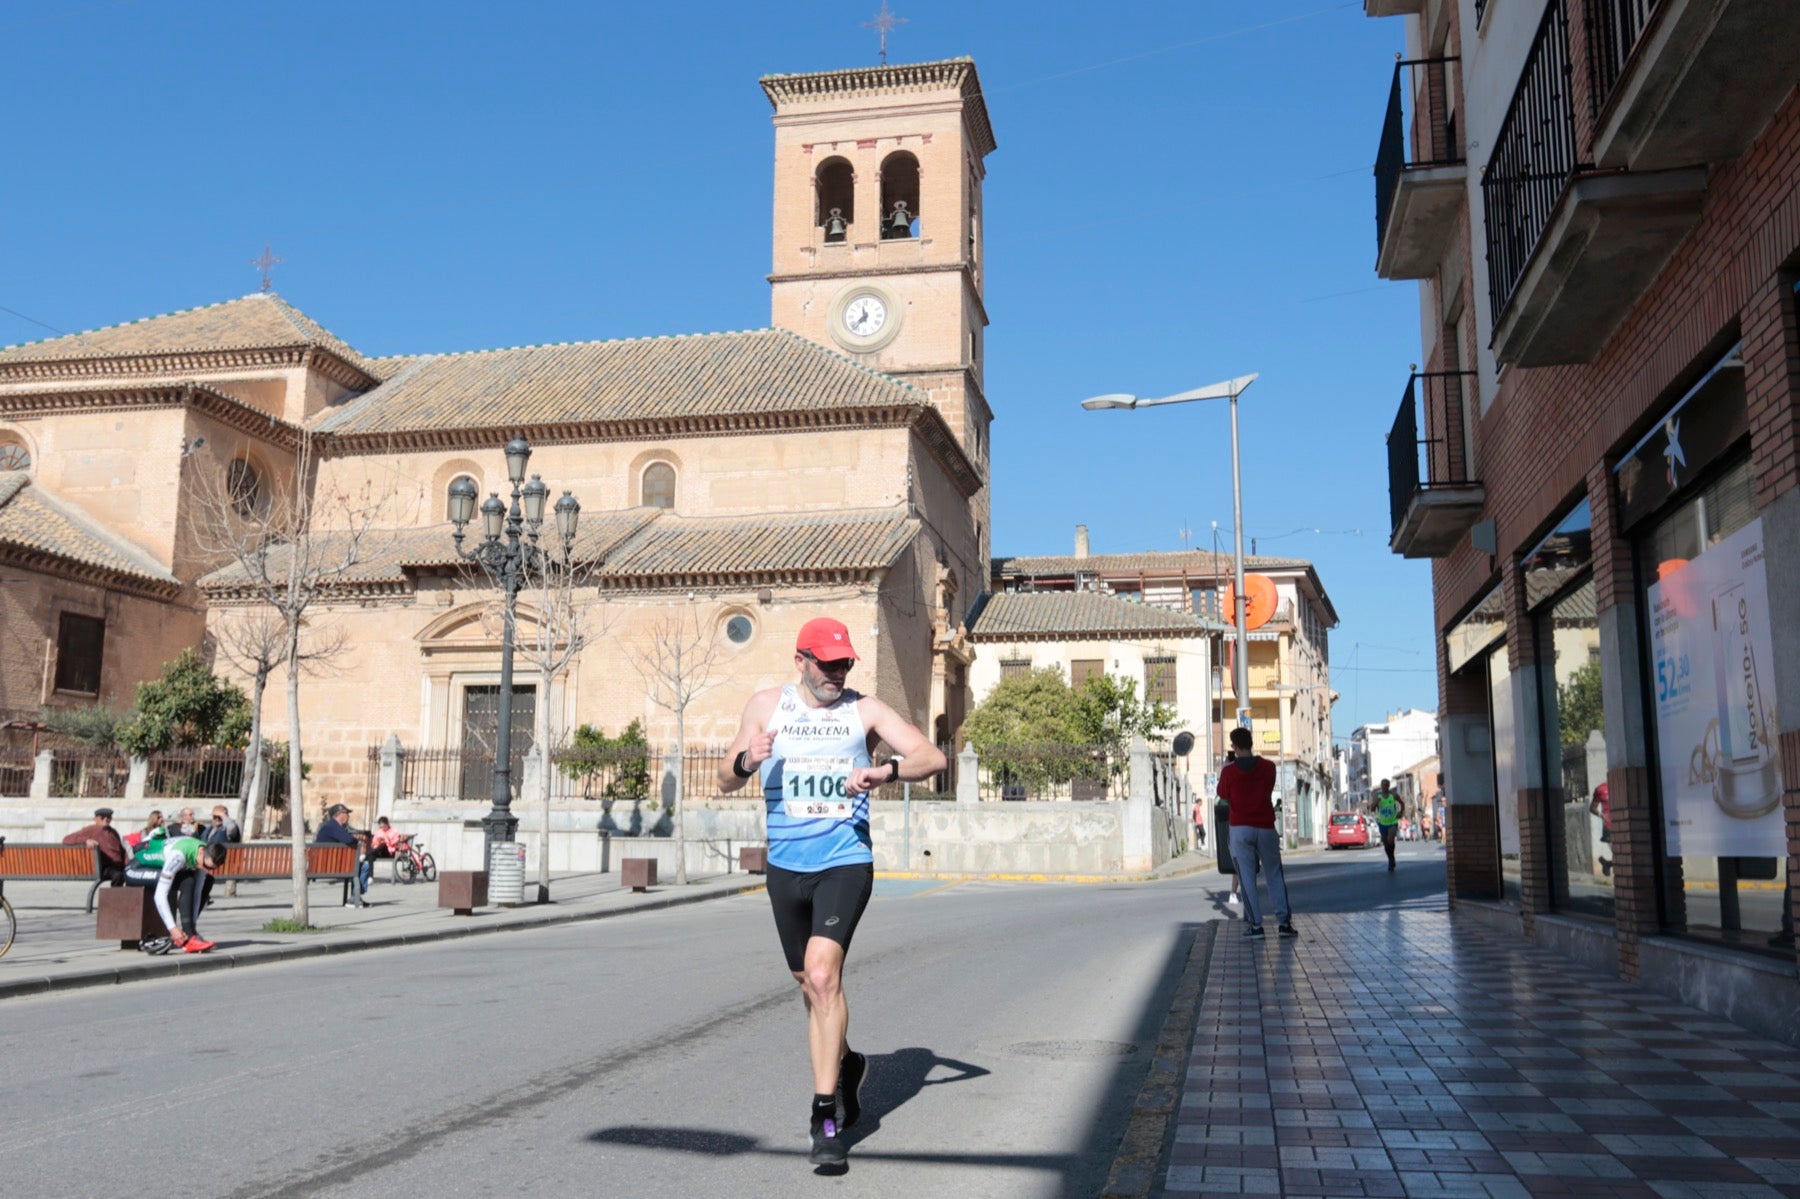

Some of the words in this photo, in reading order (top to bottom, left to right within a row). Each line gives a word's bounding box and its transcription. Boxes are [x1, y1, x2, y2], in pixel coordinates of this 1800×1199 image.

[1738, 597, 1748, 635] 5G
[1743, 642, 1759, 751] Note10+
[781, 724, 850, 736] MARACENA
[788, 775, 848, 798] 1106
